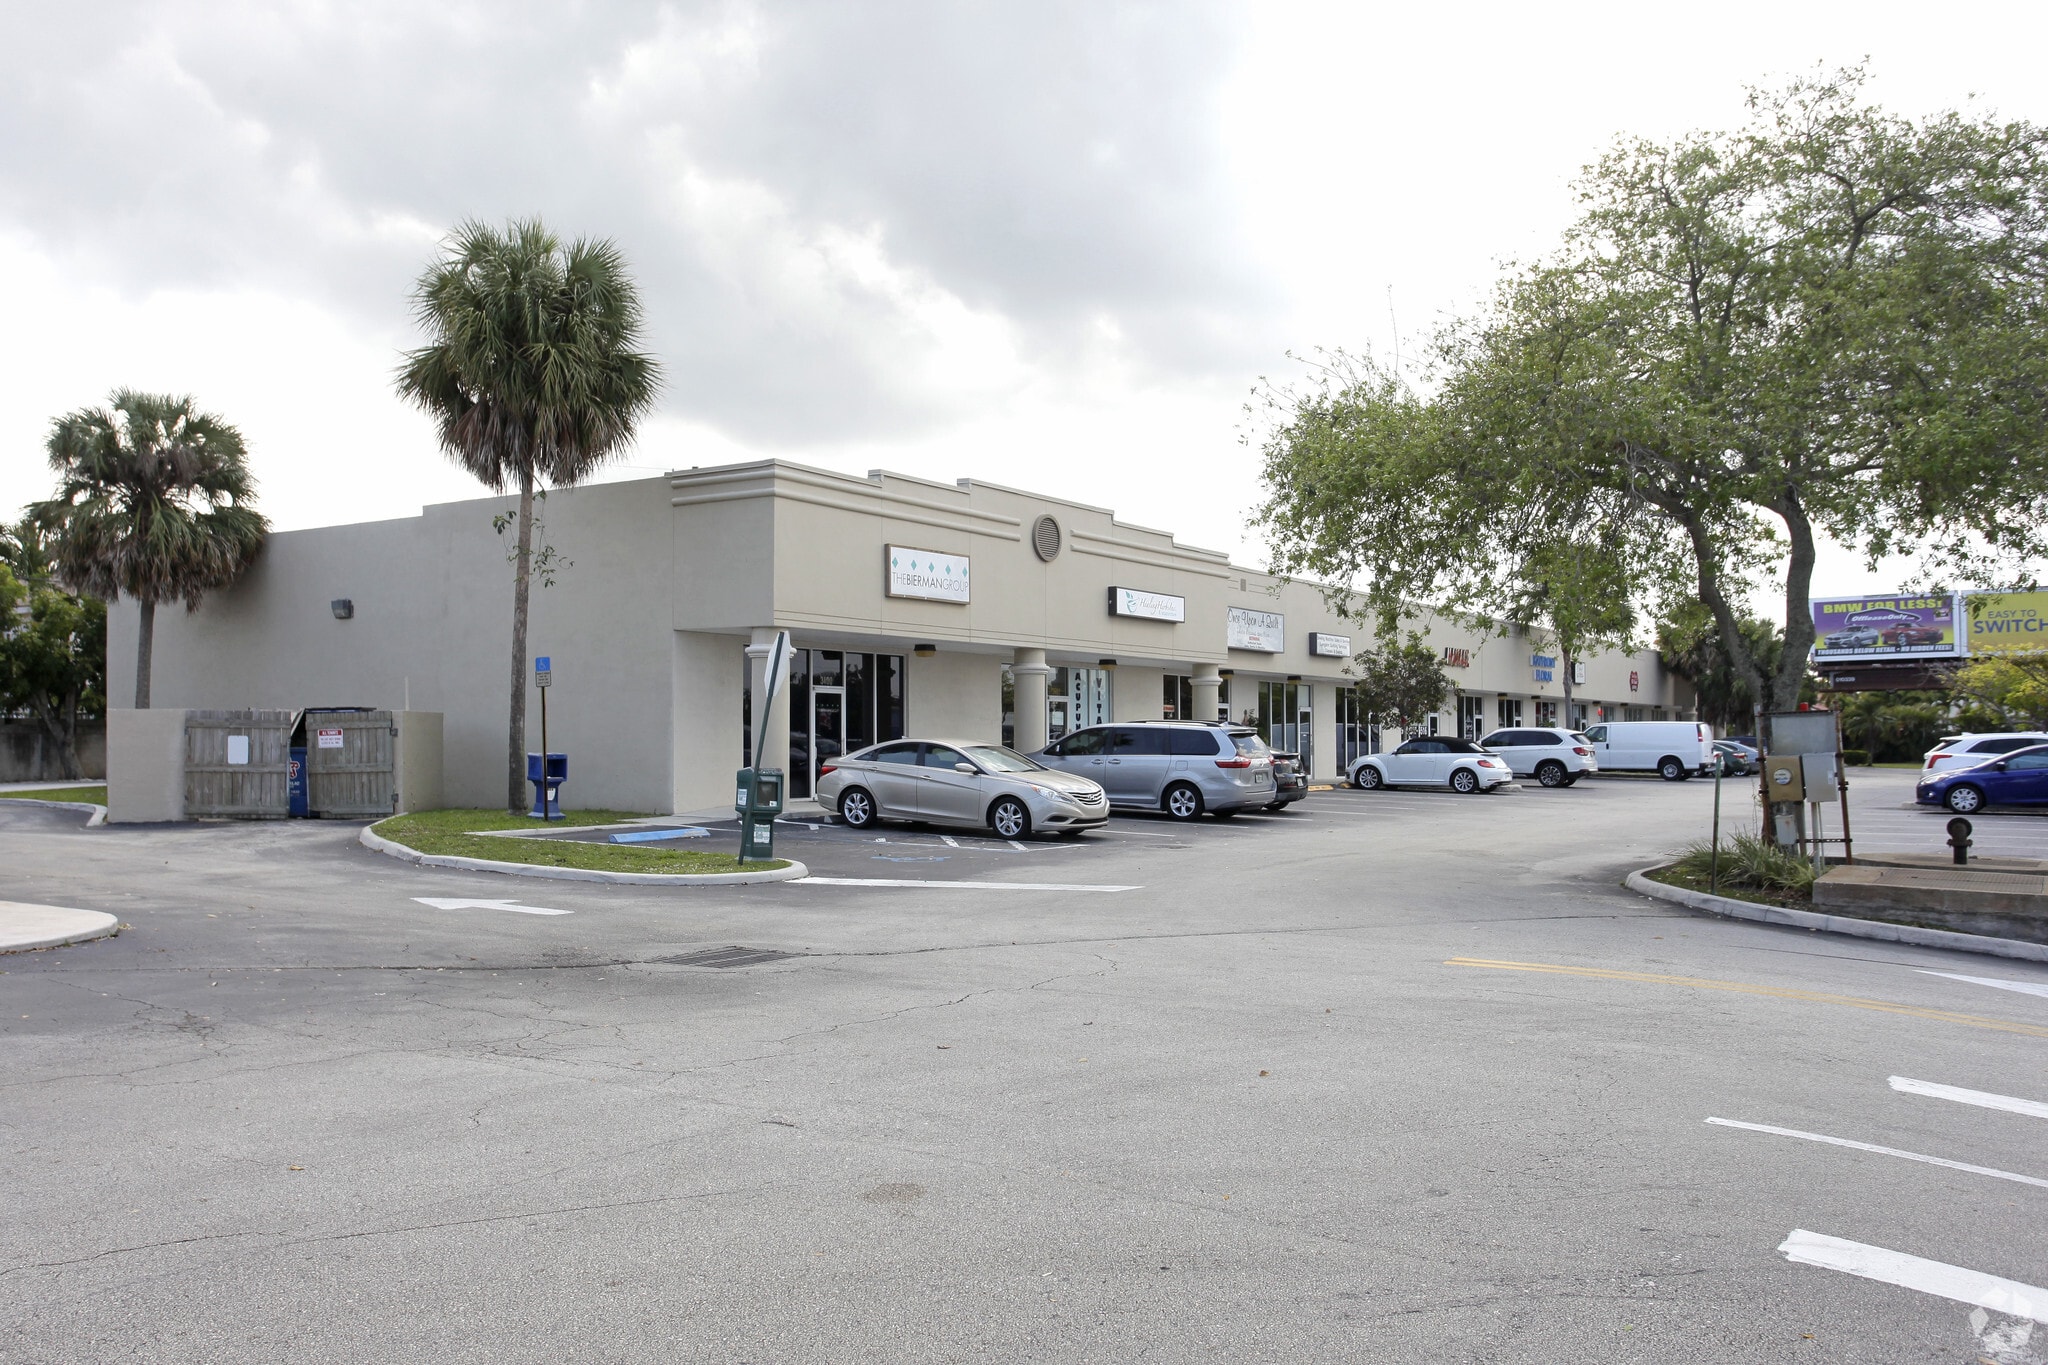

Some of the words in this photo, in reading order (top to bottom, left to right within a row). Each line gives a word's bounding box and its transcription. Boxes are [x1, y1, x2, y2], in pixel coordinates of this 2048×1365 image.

[1823, 604, 1862, 614] BMW
[1867, 601, 1895, 609] FOR
[1901, 599, 1942, 610] LESS!
[1988, 610, 2016, 618] EASY
[2021, 609, 2037, 617] TO
